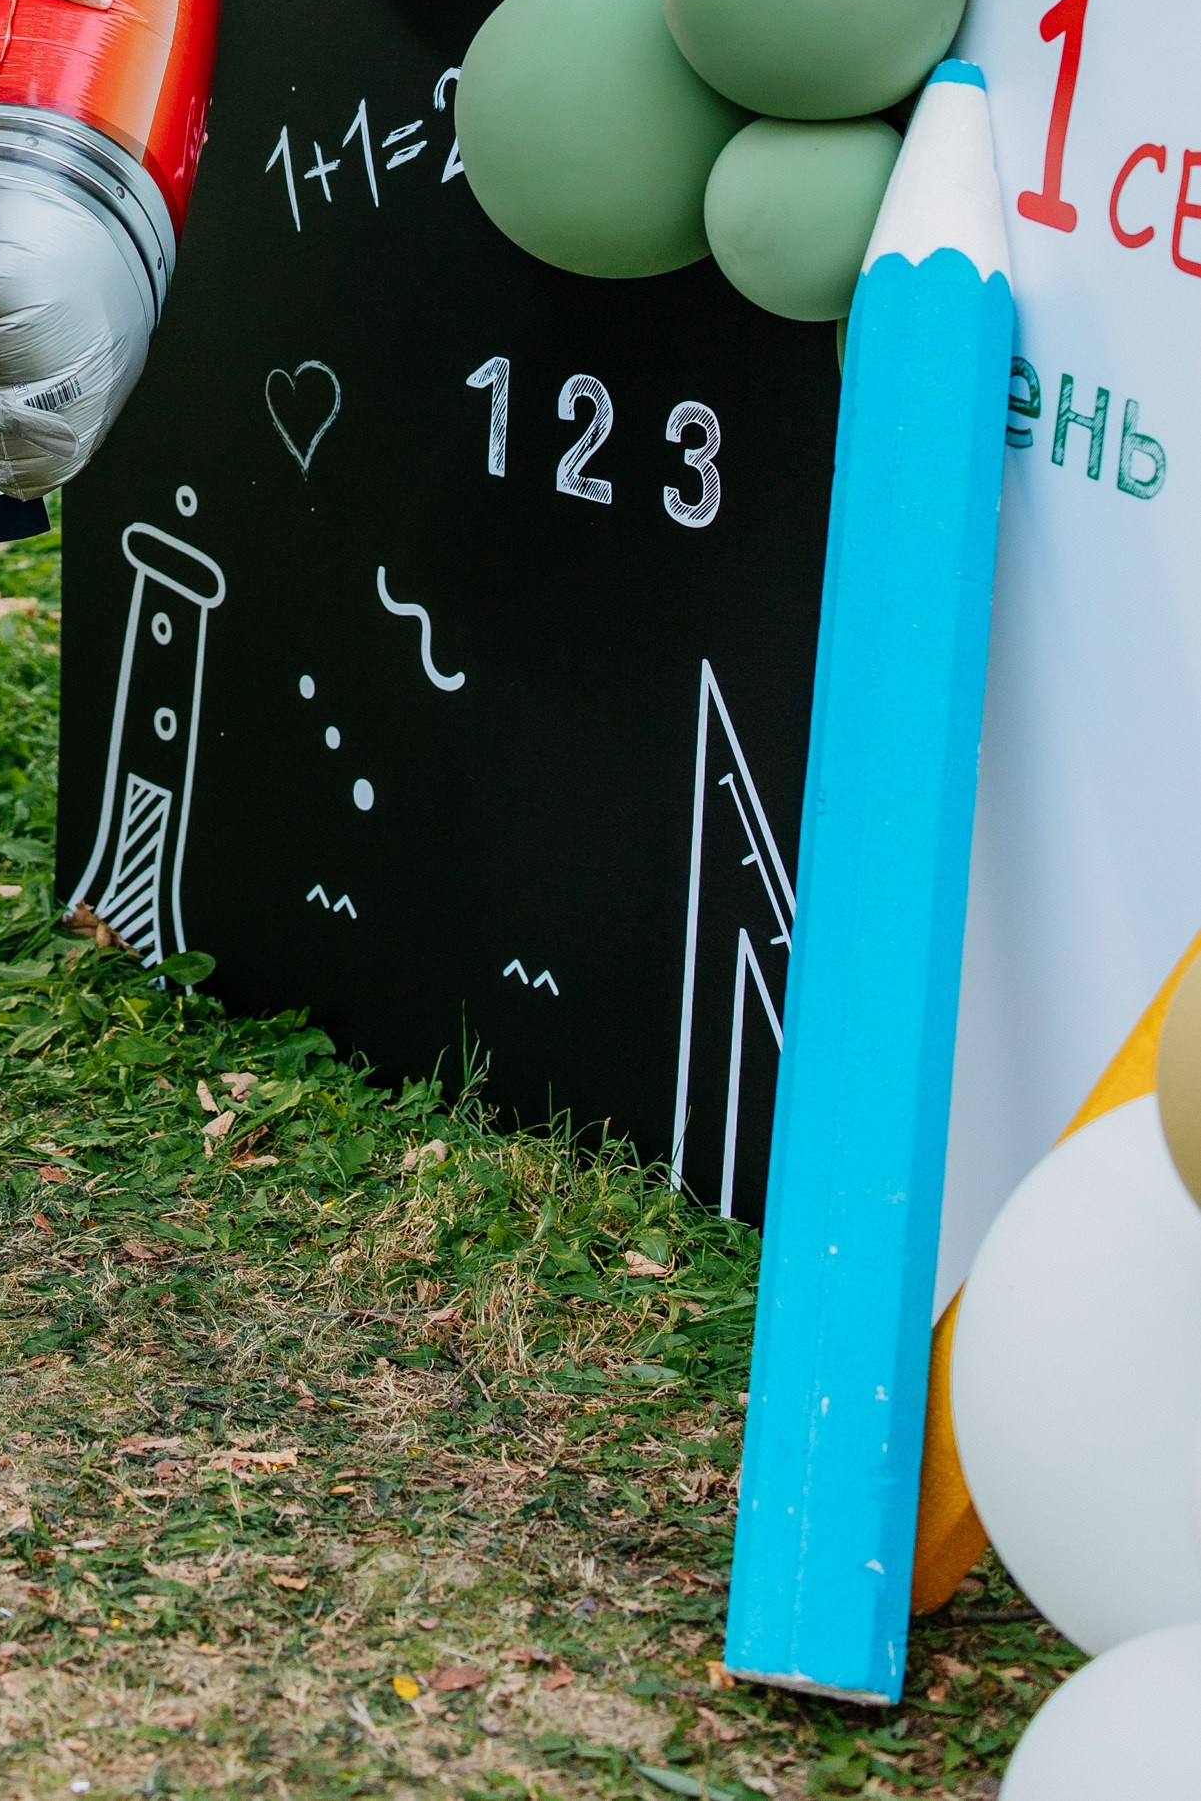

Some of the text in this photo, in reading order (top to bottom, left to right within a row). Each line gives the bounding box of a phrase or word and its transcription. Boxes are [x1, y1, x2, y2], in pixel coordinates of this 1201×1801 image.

[466, 356, 722, 528] 1 2 3
[1006, 356, 1168, 500] ень
